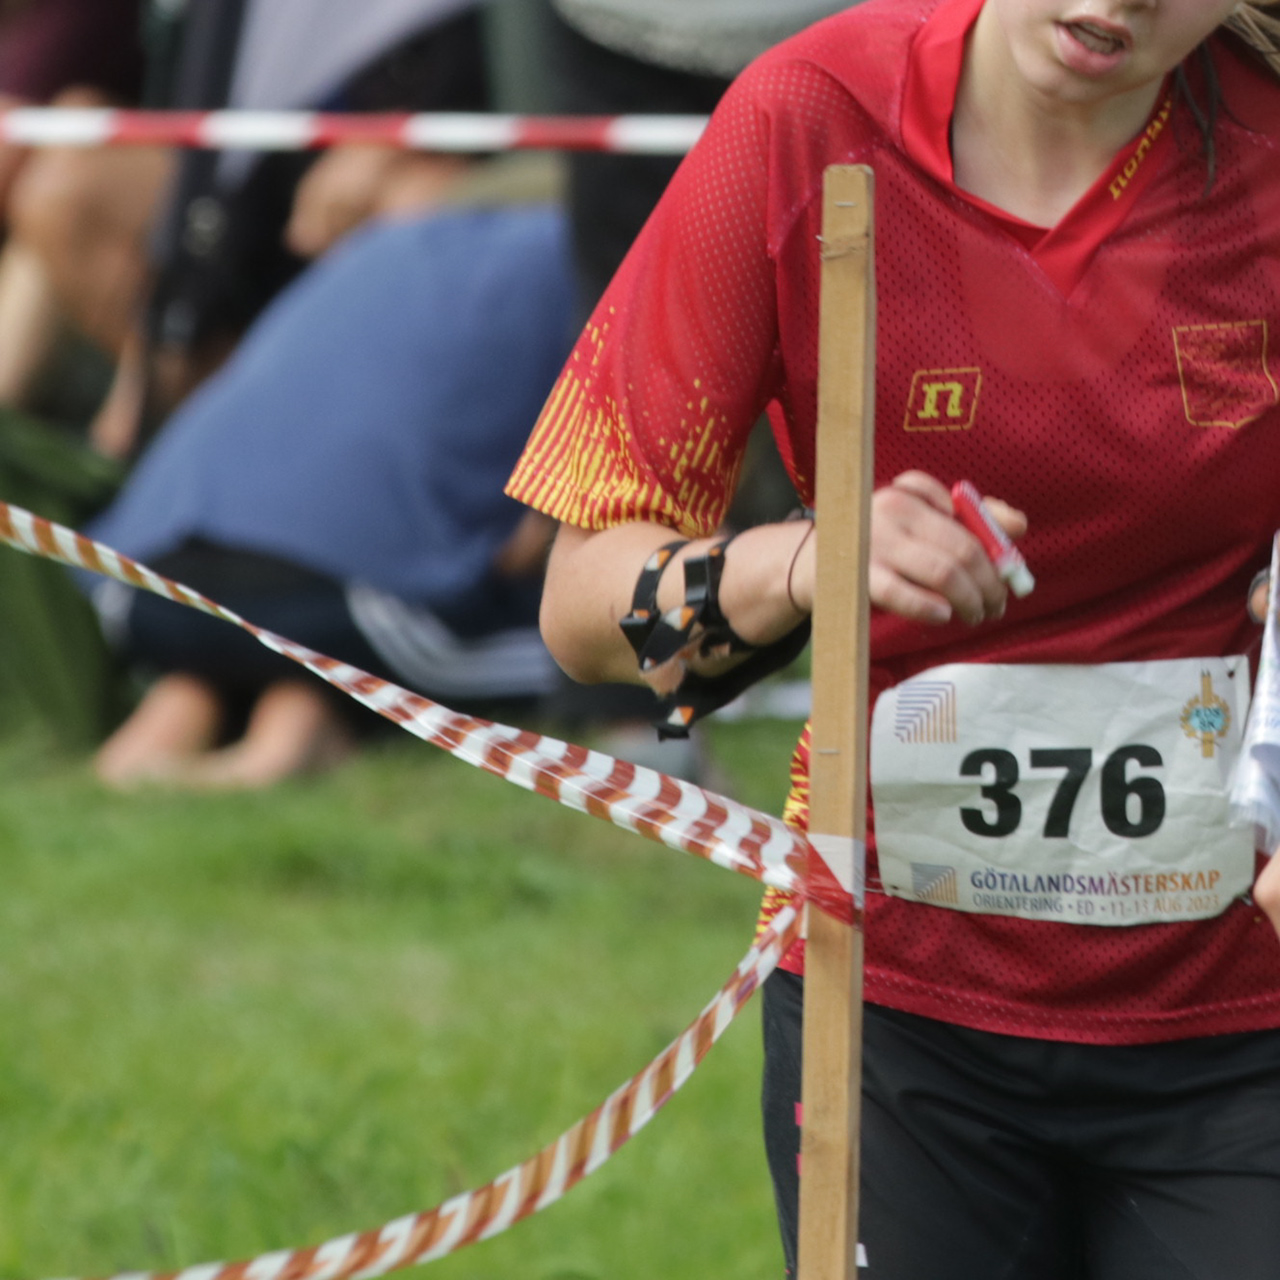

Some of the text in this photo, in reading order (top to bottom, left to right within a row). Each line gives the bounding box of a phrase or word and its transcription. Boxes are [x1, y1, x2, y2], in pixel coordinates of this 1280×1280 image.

[959, 744, 1166, 838] 376
[970, 867, 1221, 896] GÖTALANDSMÄSTERSKAP
[972, 893, 1063, 914] ORIENTERING
[1076, 900, 1095, 915] ED
[1109, 900, 1149, 916] 11-13
[1153, 897, 1182, 913] AUG
